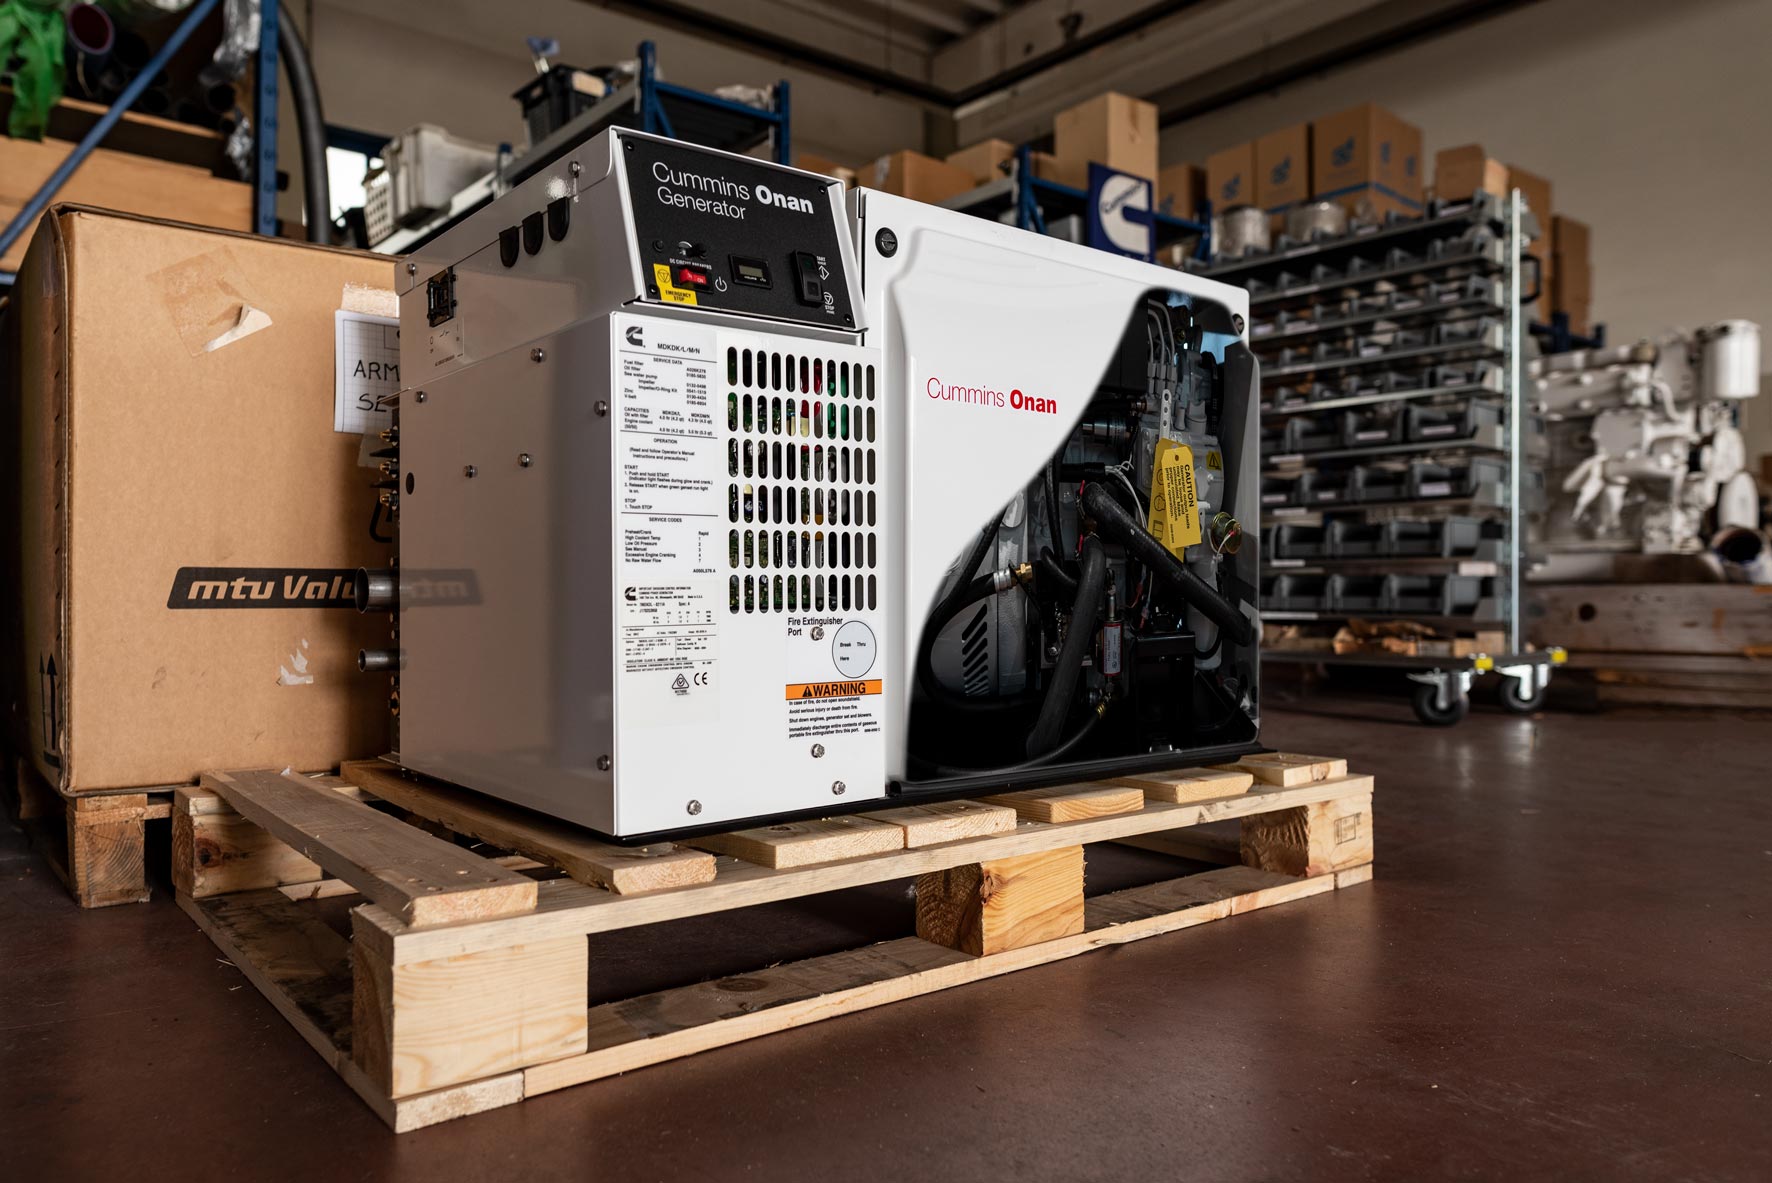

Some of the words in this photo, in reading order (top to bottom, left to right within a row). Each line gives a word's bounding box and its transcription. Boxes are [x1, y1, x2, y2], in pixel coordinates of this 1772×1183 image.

[652, 162, 750, 200] Cummins
[755, 185, 814, 214] Onan
[657, 187, 746, 220] Generator
[657, 343, 700, 354] MDKDK/L/M/N
[353, 360, 400, 382] ARM
[927, 377, 1005, 408] Cummins
[1010, 389, 1057, 414] Onan
[1184, 464, 1194, 507] CAUTION
[188, 576, 275, 599] mtu
[788, 628, 802, 636] Port
[803, 617, 843, 626] Extinguisher
[813, 682, 866, 696] WARNING
